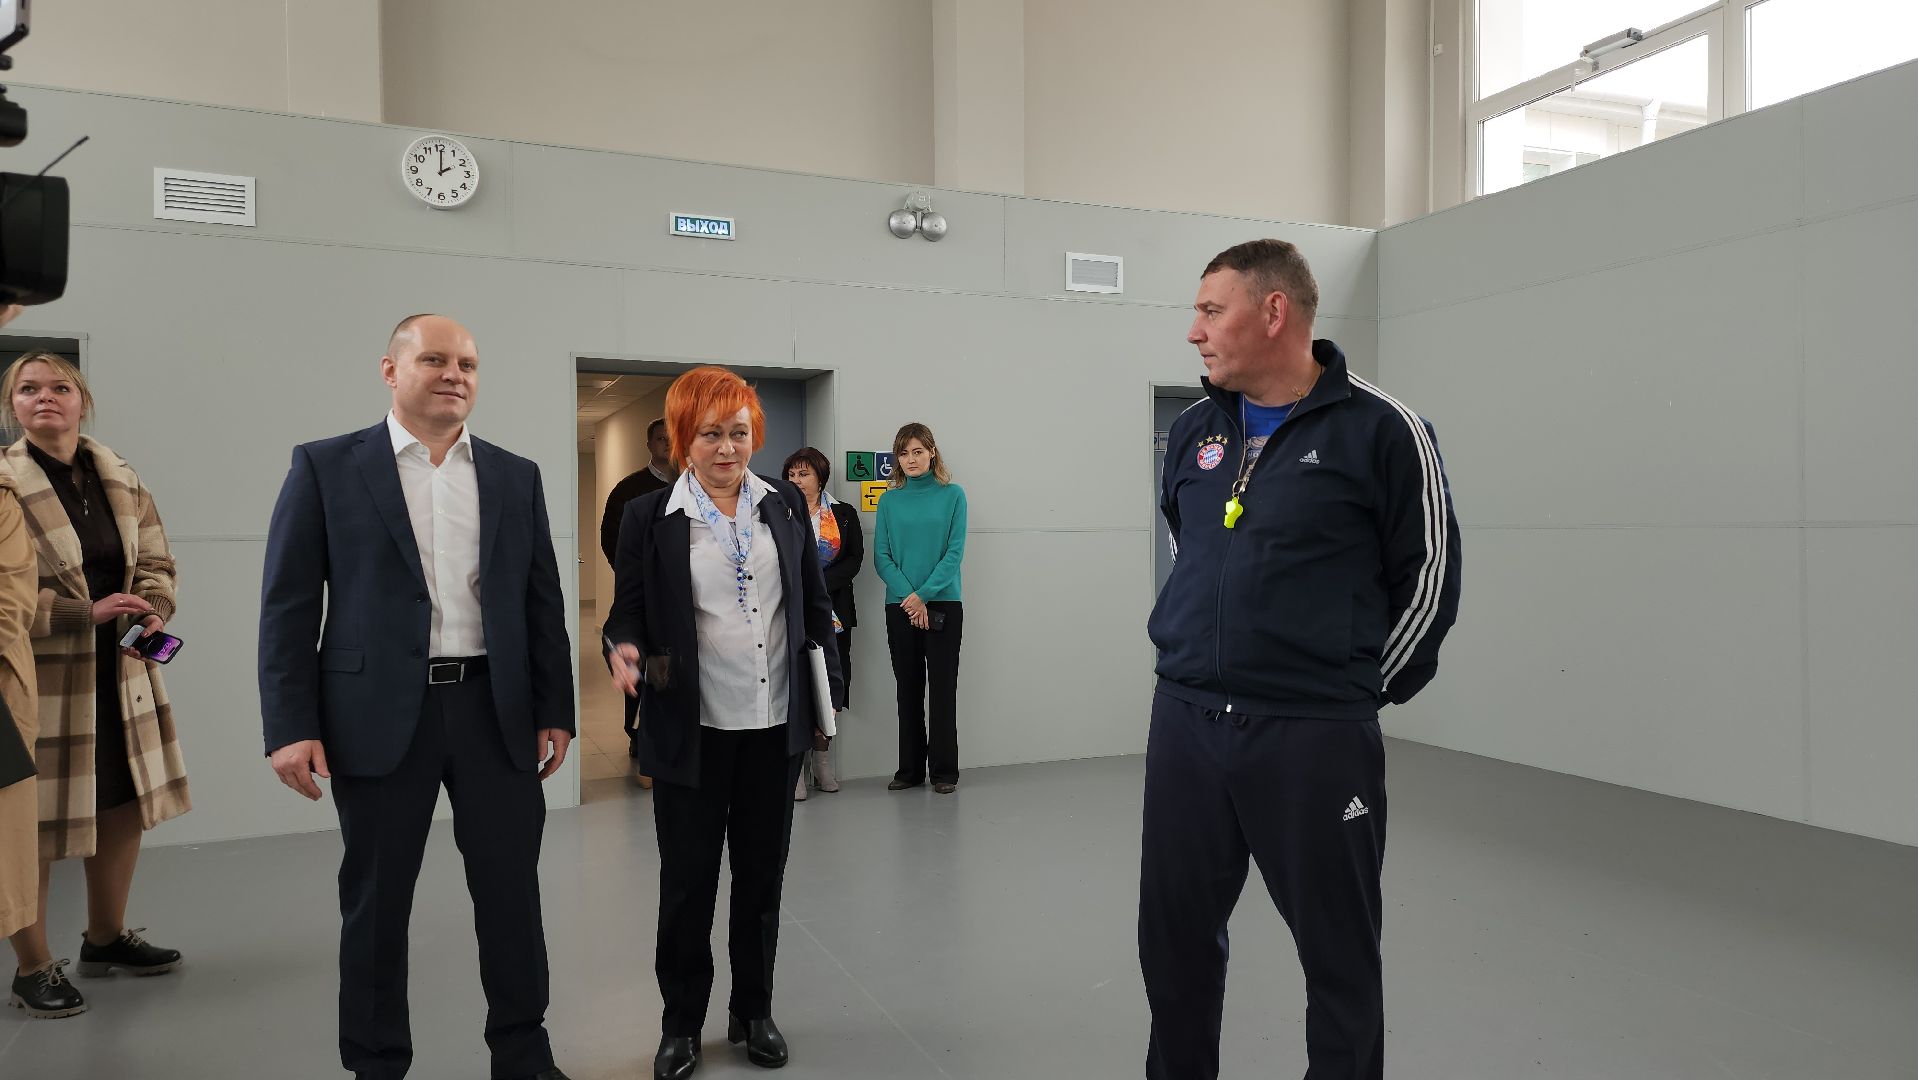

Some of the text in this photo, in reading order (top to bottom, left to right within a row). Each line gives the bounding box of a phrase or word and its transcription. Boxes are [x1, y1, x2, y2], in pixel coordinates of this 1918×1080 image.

[423, 147, 432, 155] 11
[434, 144, 445, 152] 12
[414, 154, 425, 163] 10
[459, 159, 466, 167] 2
[410, 166, 418, 174] 9
[416, 178, 423, 187] 8
[425, 187, 432, 196] 7
[451, 190, 458, 198] 5
[677, 218, 729, 235] ВЫХОД
[1342, 807, 1369, 821] adidas
